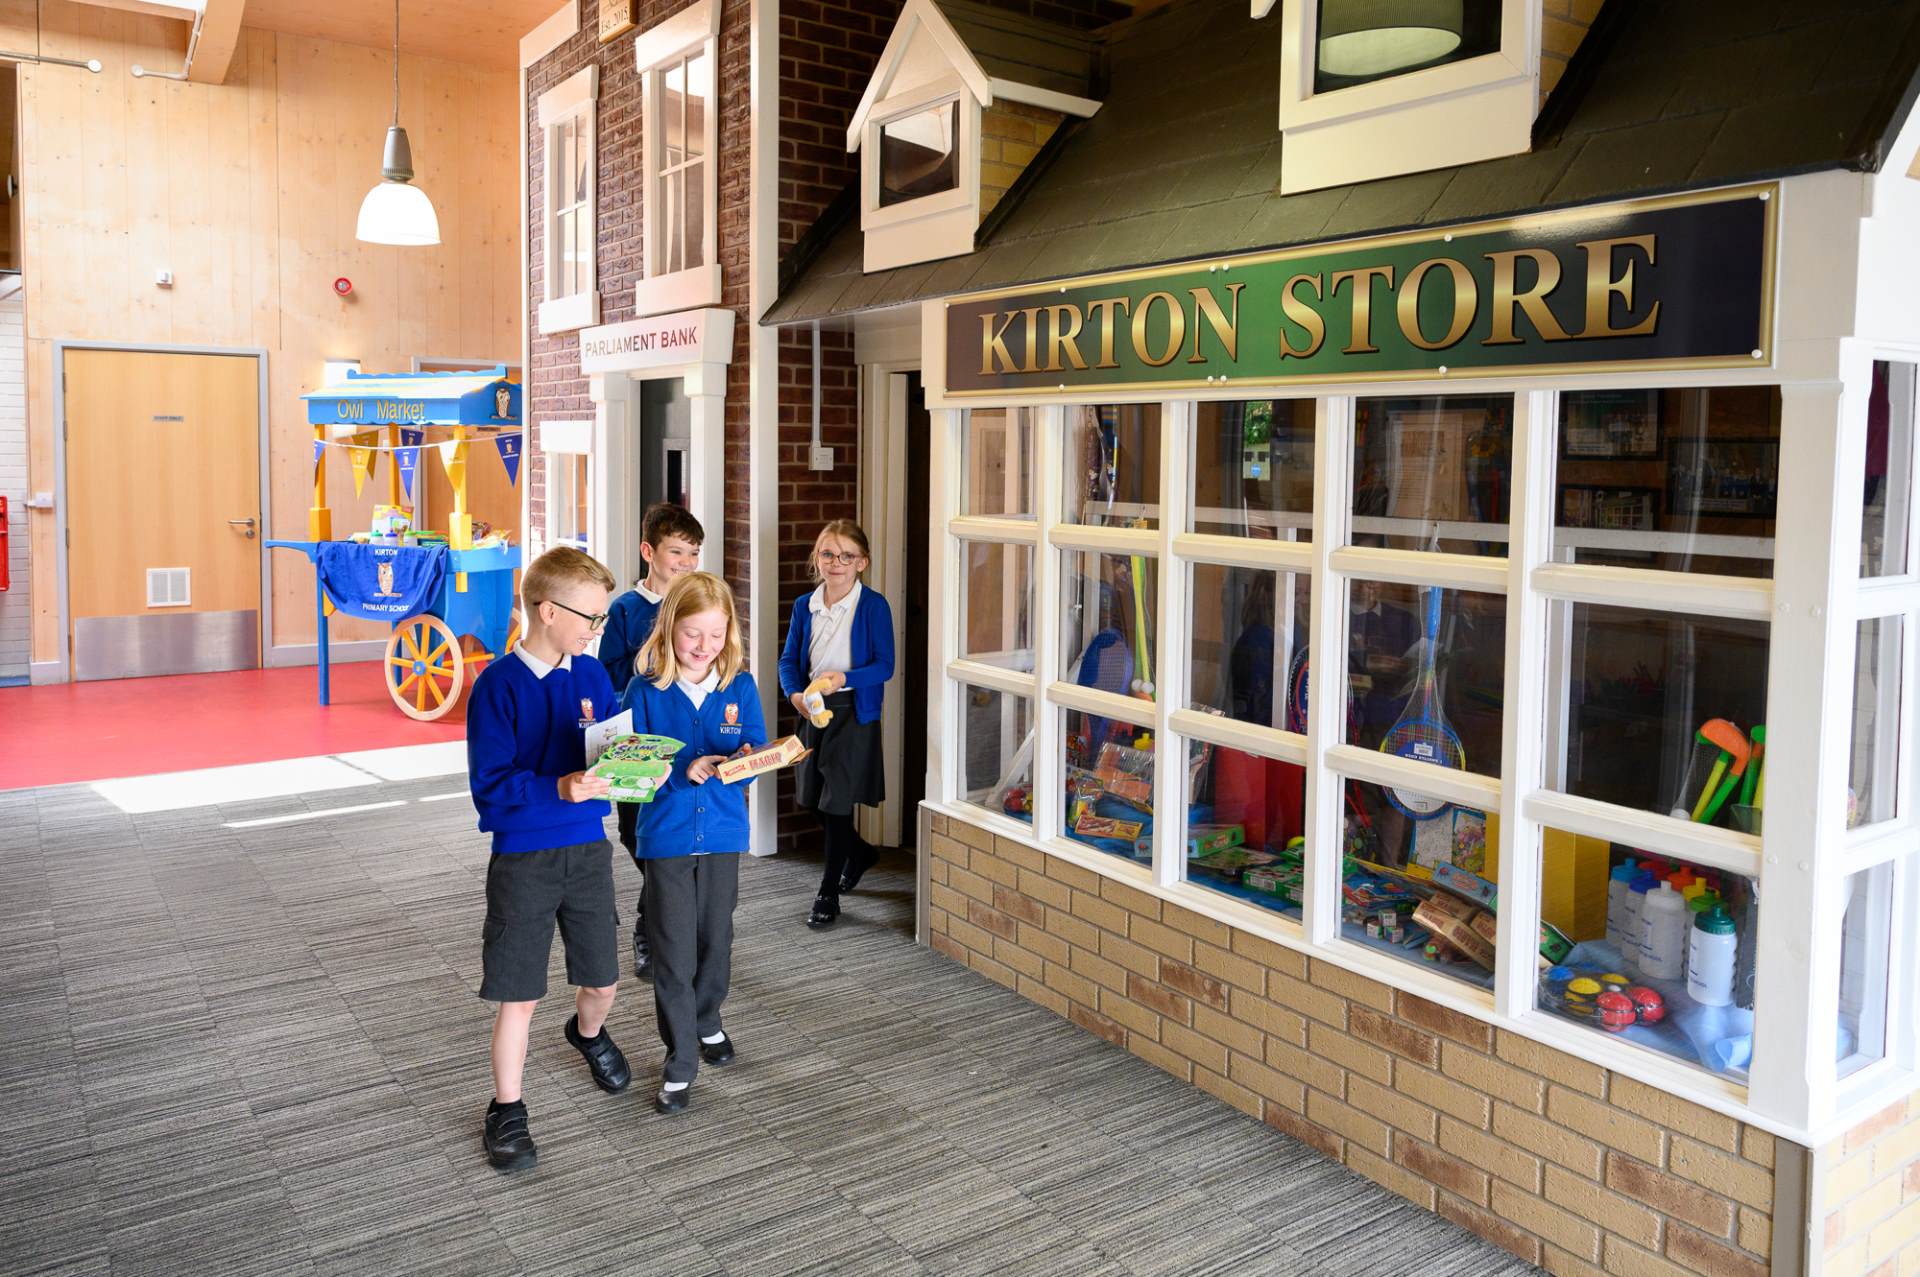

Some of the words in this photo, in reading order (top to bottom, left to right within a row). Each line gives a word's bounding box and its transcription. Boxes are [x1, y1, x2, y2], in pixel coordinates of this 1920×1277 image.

[977, 282, 1247, 375] KIRTON
[1280, 234, 1662, 359] STORE
[585, 333, 657, 357] PARLIAMENT
[661, 326, 697, 348] BANK
[337, 399, 364, 419] Owl
[377, 399, 425, 420] Market
[362, 603, 388, 611] PRIMARY
[720, 726, 741, 735] KIRTON
